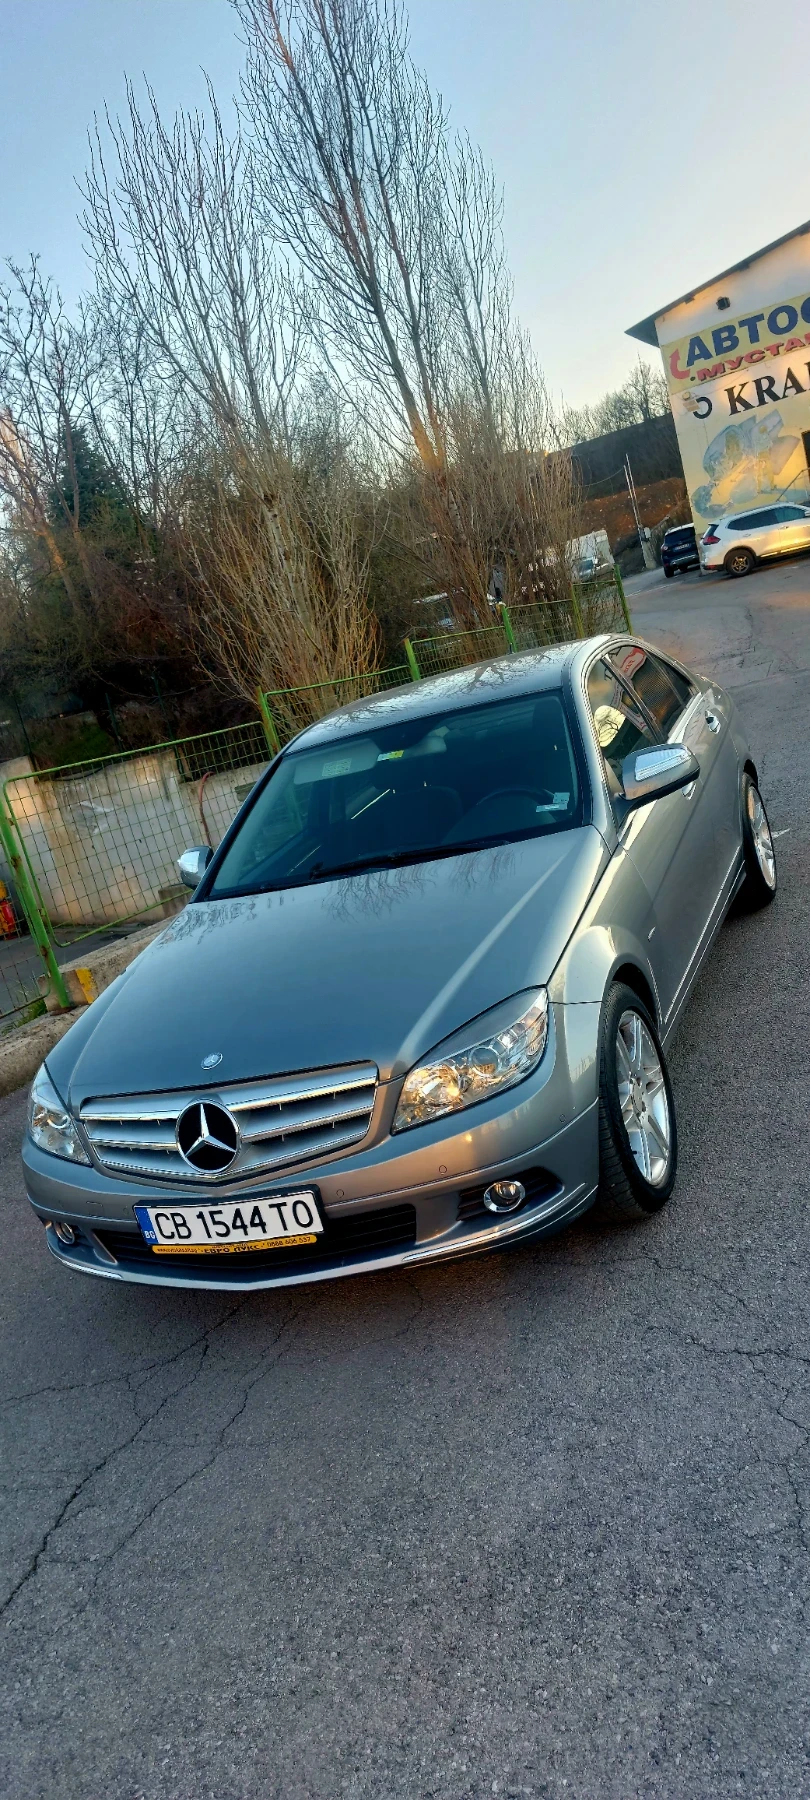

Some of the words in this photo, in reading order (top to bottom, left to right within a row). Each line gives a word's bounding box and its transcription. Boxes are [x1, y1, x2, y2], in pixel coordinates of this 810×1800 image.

[724, 361, 810, 416] KRA
[144, 1230, 155, 1240] BG
[154, 1212, 192, 1239] CB
[196, 1205, 267, 1239] 1544
[268, 1200, 314, 1231] TO
